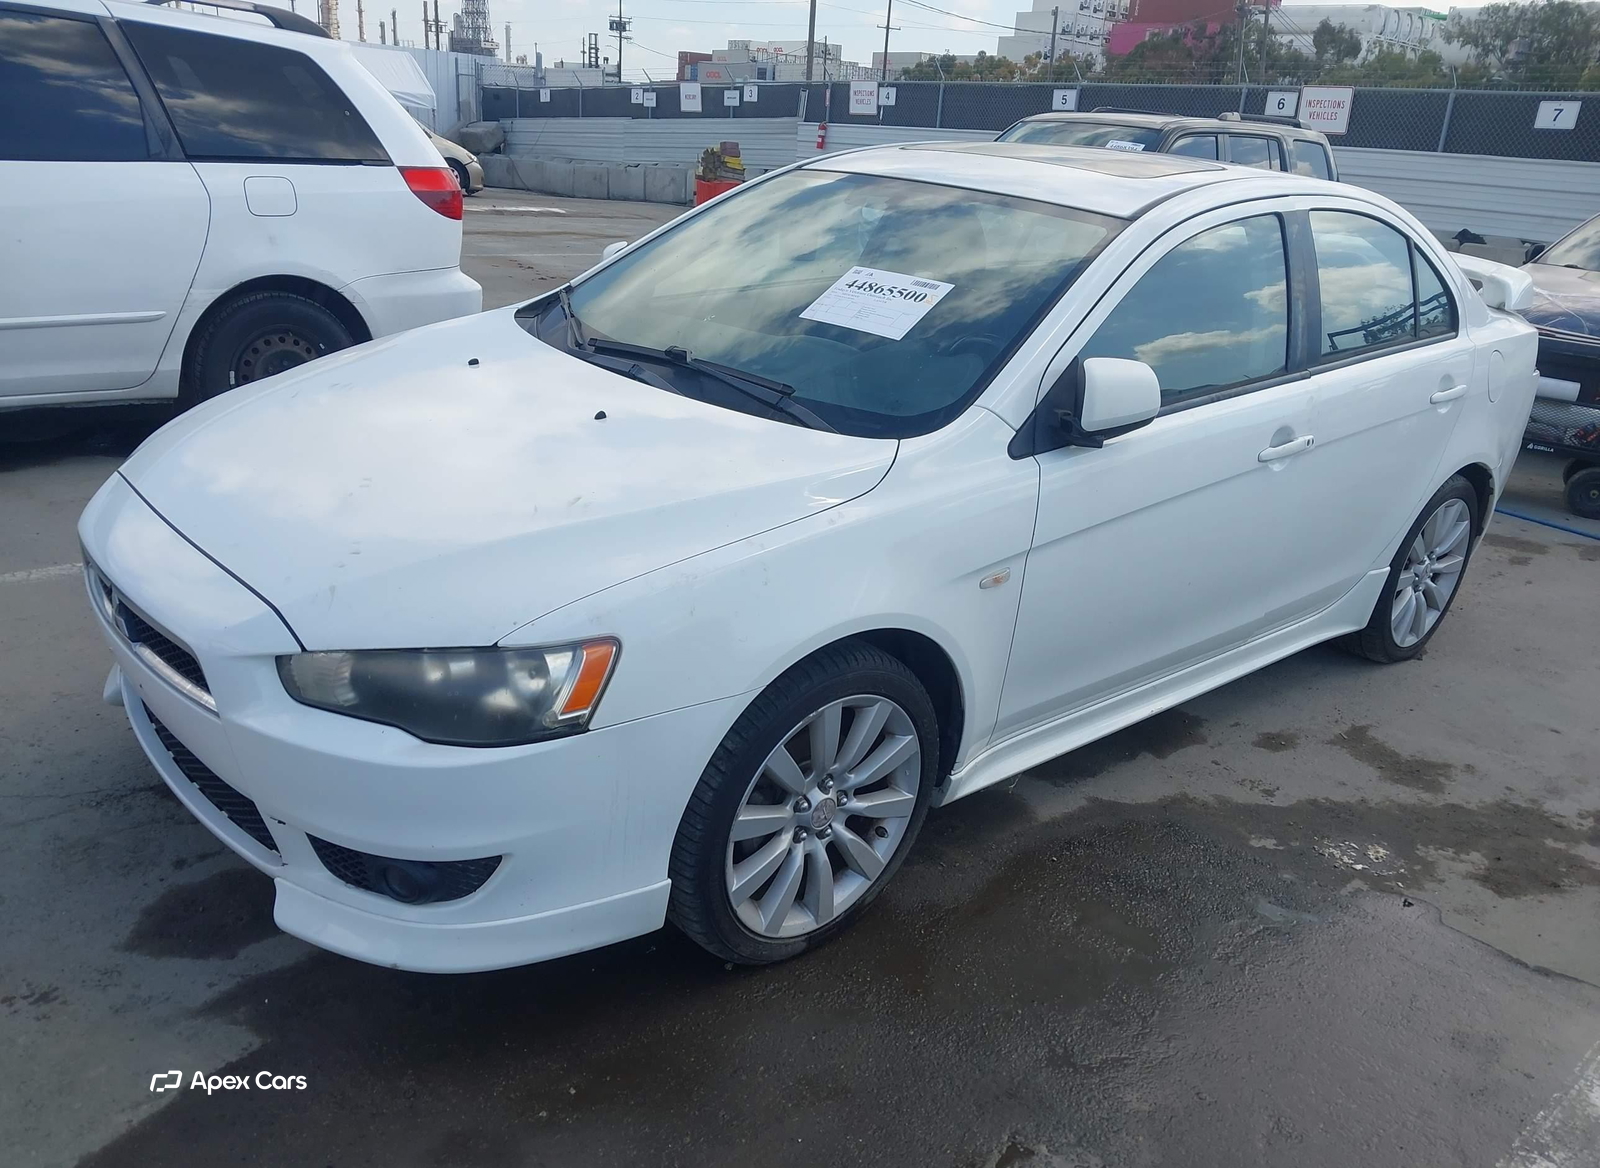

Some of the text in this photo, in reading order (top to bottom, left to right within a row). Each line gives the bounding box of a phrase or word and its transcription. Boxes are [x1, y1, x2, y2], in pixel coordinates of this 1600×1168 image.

[748, 89, 753, 98] 3
[885, 91, 890, 101] 4
[1061, 94, 1068, 105] 5
[1277, 97, 1286, 110] 6
[1305, 99, 1346, 109] INSPECTIONS
[1309, 111, 1338, 120] VEHICLES
[1553, 108, 1564, 121] 7
[845, 279, 928, 303] 44865500
[1534, 445, 1554, 453] GORILLA
